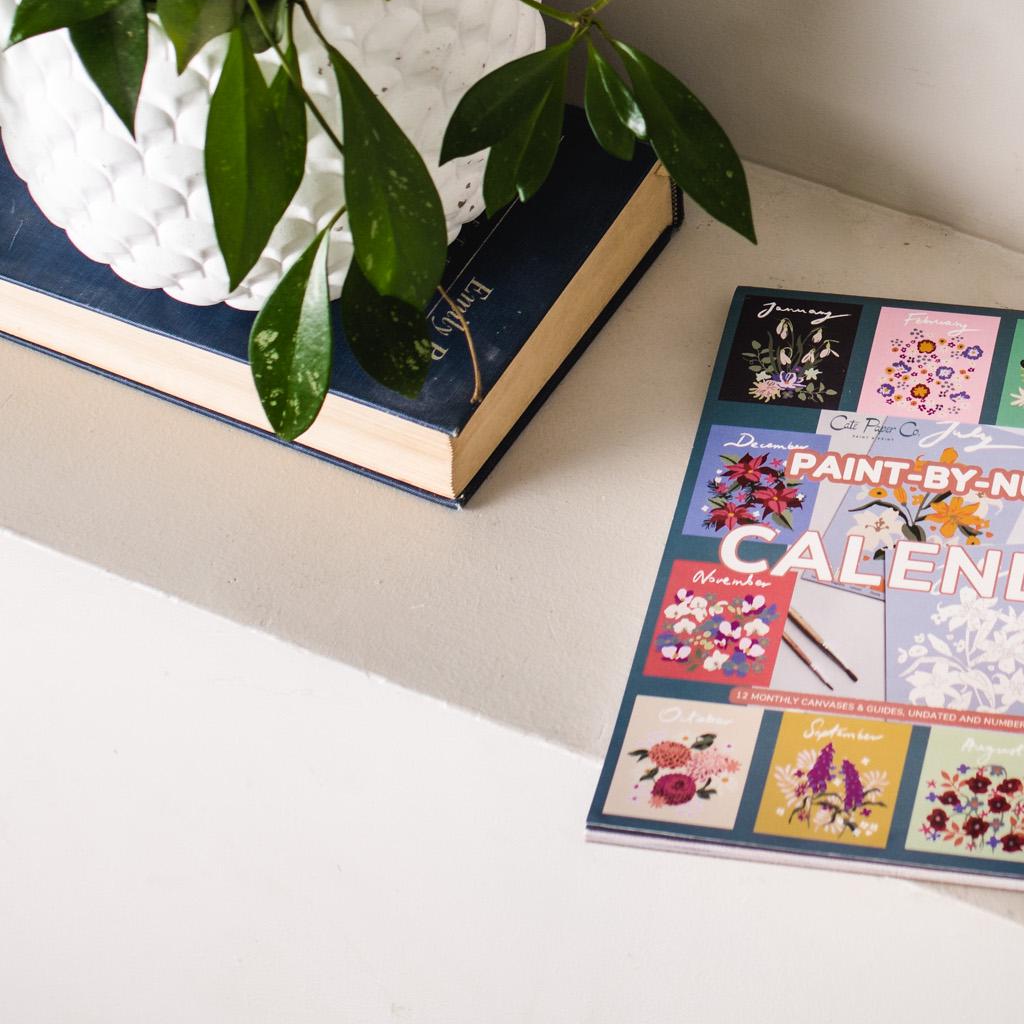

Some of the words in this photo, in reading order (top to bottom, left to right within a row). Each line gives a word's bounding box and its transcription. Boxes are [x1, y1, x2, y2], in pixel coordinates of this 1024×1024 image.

[757, 301, 851, 325] January
[903, 312, 980, 334] February
[864, 417, 897, 434] Paper
[918, 420, 1024, 453] July
[693, 568, 771, 588] November
[735, 690, 748, 700] 12
[751, 693, 799, 705] MONTHLY
[801, 697, 854, 711] CANVASES
[857, 703, 864, 712] &
[908, 709, 957, 722] UNDATED
[959, 714, 981, 725] AND
